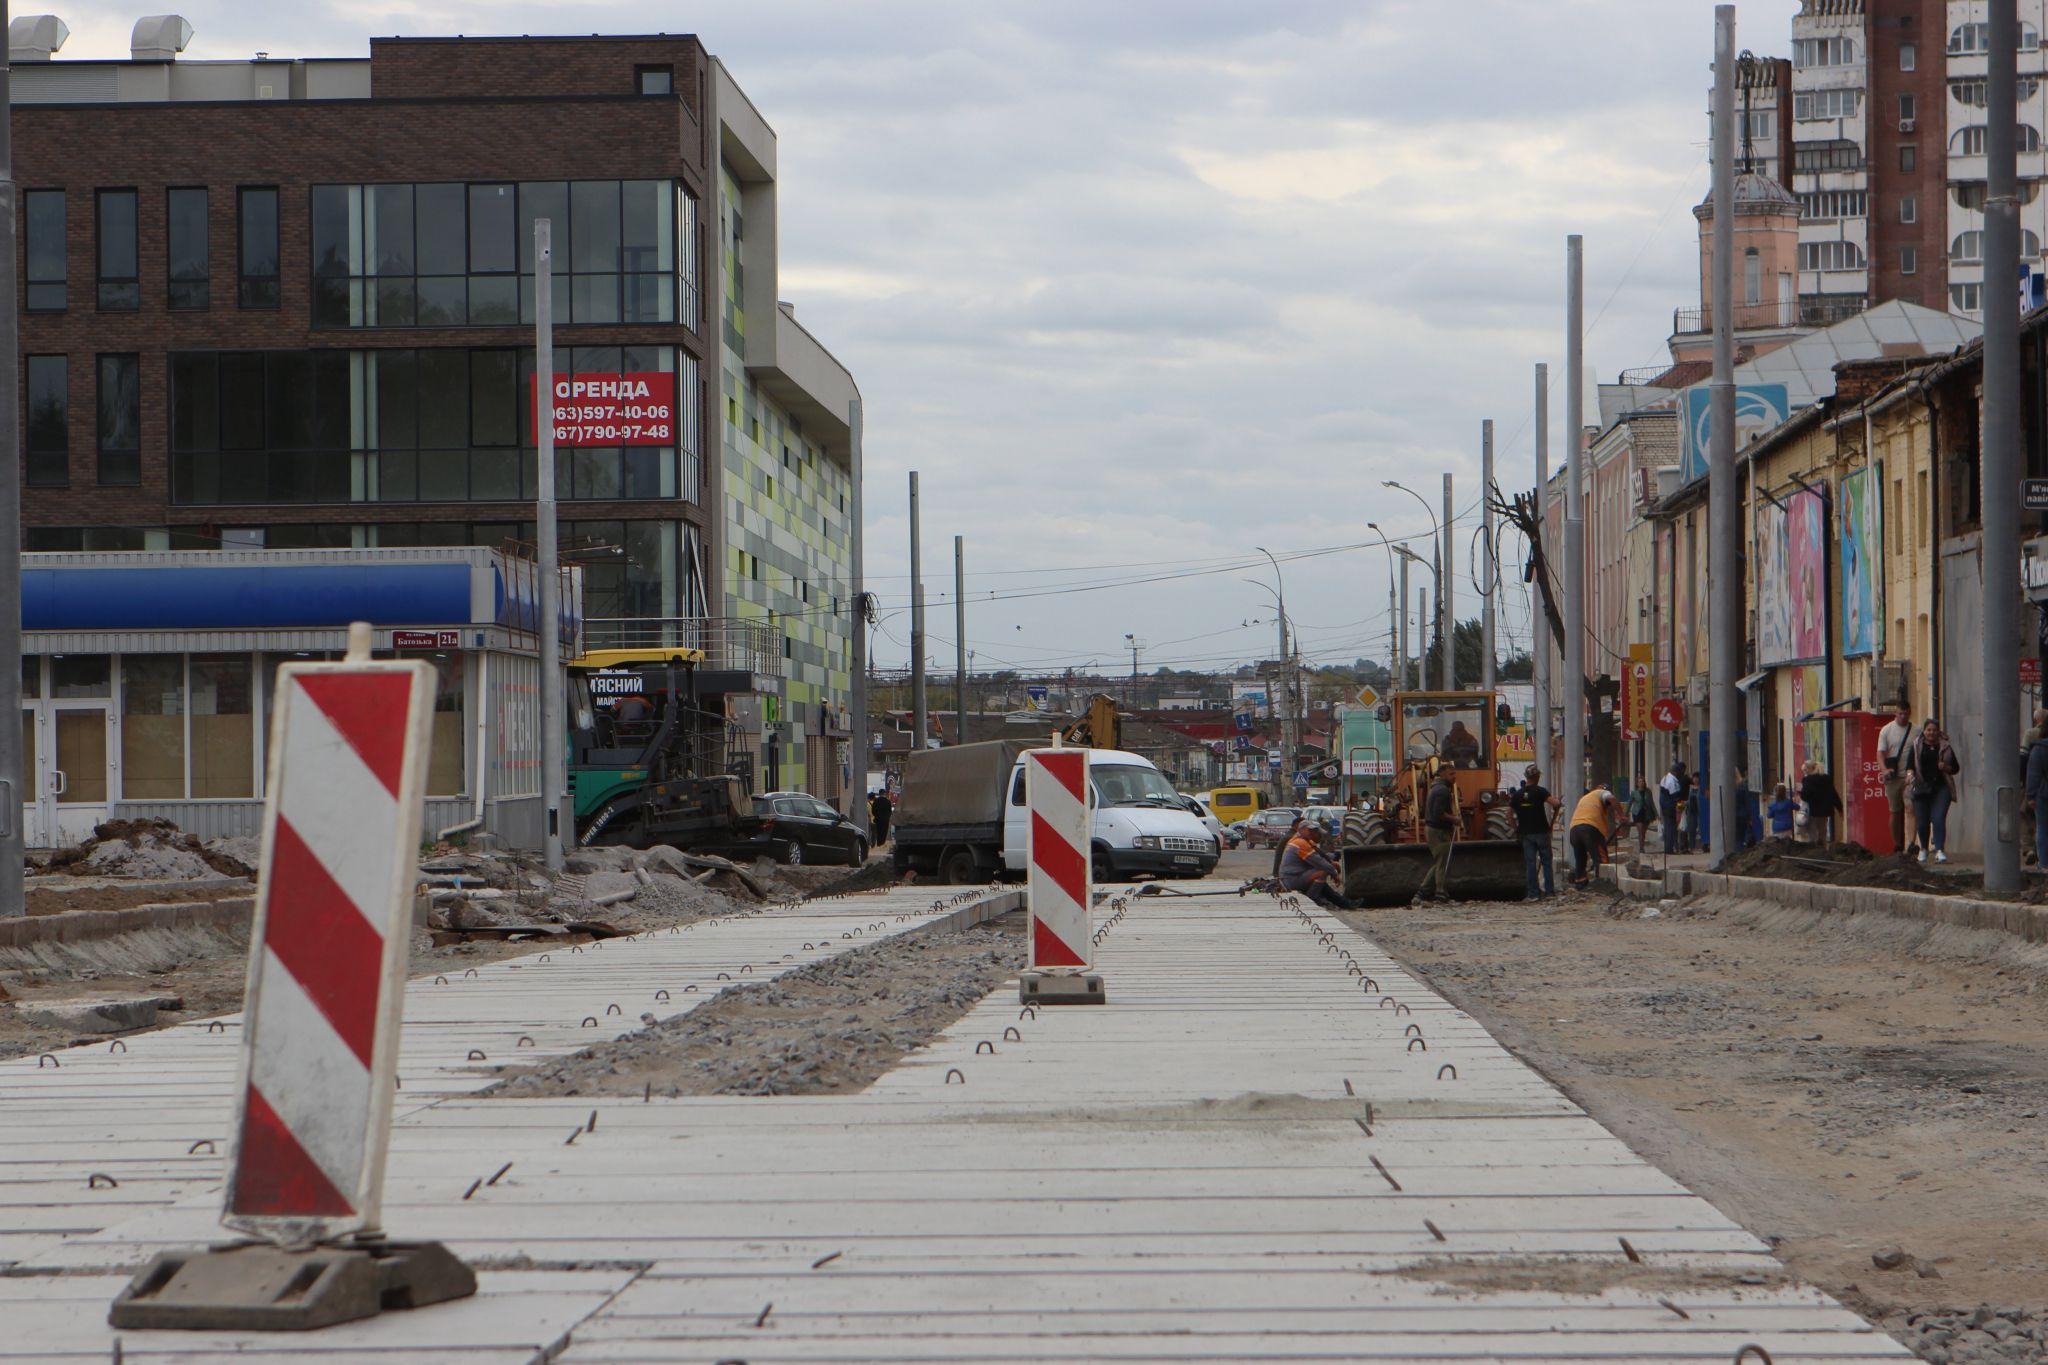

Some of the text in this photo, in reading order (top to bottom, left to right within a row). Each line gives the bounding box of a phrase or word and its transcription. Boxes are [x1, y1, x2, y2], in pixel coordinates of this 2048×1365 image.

[556, 381, 650, 400] ОРЕНДА
[552, 405, 669, 423] 63)597-40-06
[553, 424, 669, 442] 67)790-97-48
[2031, 484, 2048, 493] М'я
[441, 634, 457, 644] 21а
[1636, 665, 1646, 729] АВРОРА
